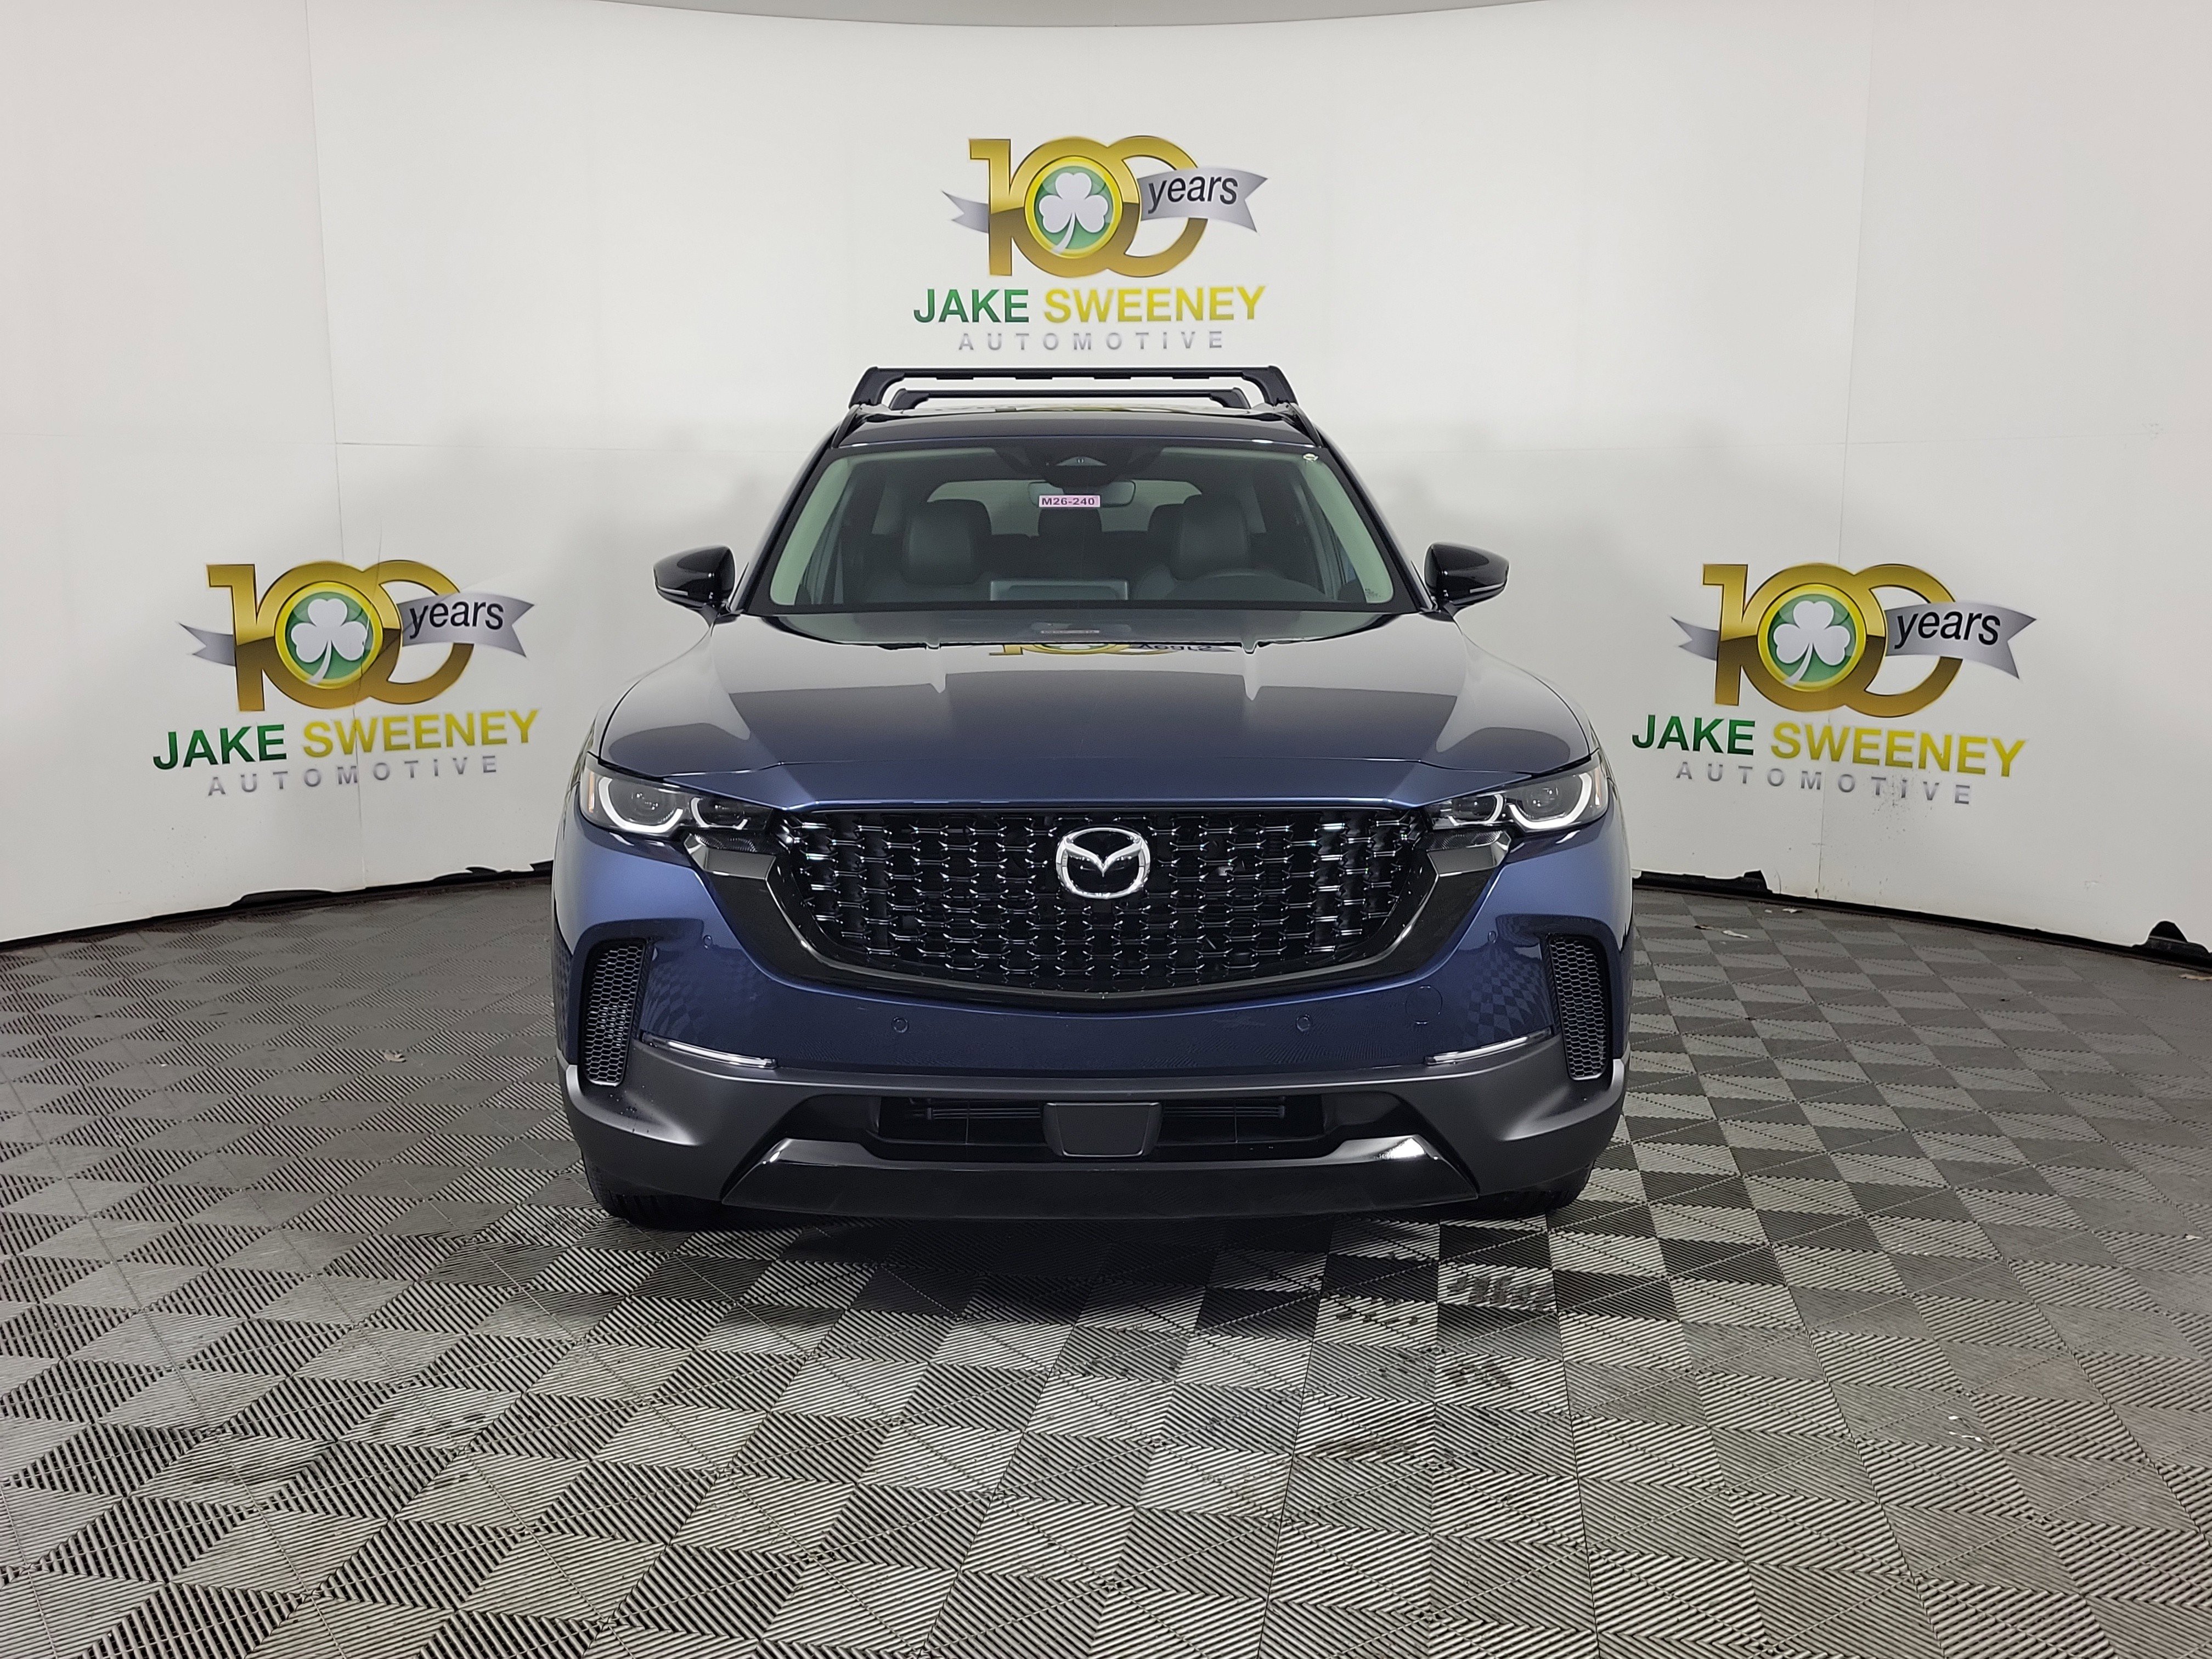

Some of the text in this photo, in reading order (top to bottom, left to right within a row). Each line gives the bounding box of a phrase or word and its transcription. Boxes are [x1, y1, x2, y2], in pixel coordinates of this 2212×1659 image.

[968, 136, 1239, 278] 100 years
[913, 286, 1266, 324] JAKE SWEENEY
[958, 331, 1223, 351] AUTOMOTIVE
[206, 560, 504, 712] 100 years
[1702, 562, 2001, 718] 100 years
[153, 709, 539, 770] JAKE SWEENEY
[1632, 714, 2025, 777] JAKE SWEENEY
[207, 755, 498, 797] AUTOMOTIVE
[1676, 761, 1971, 805] AUTOMOTIVE
